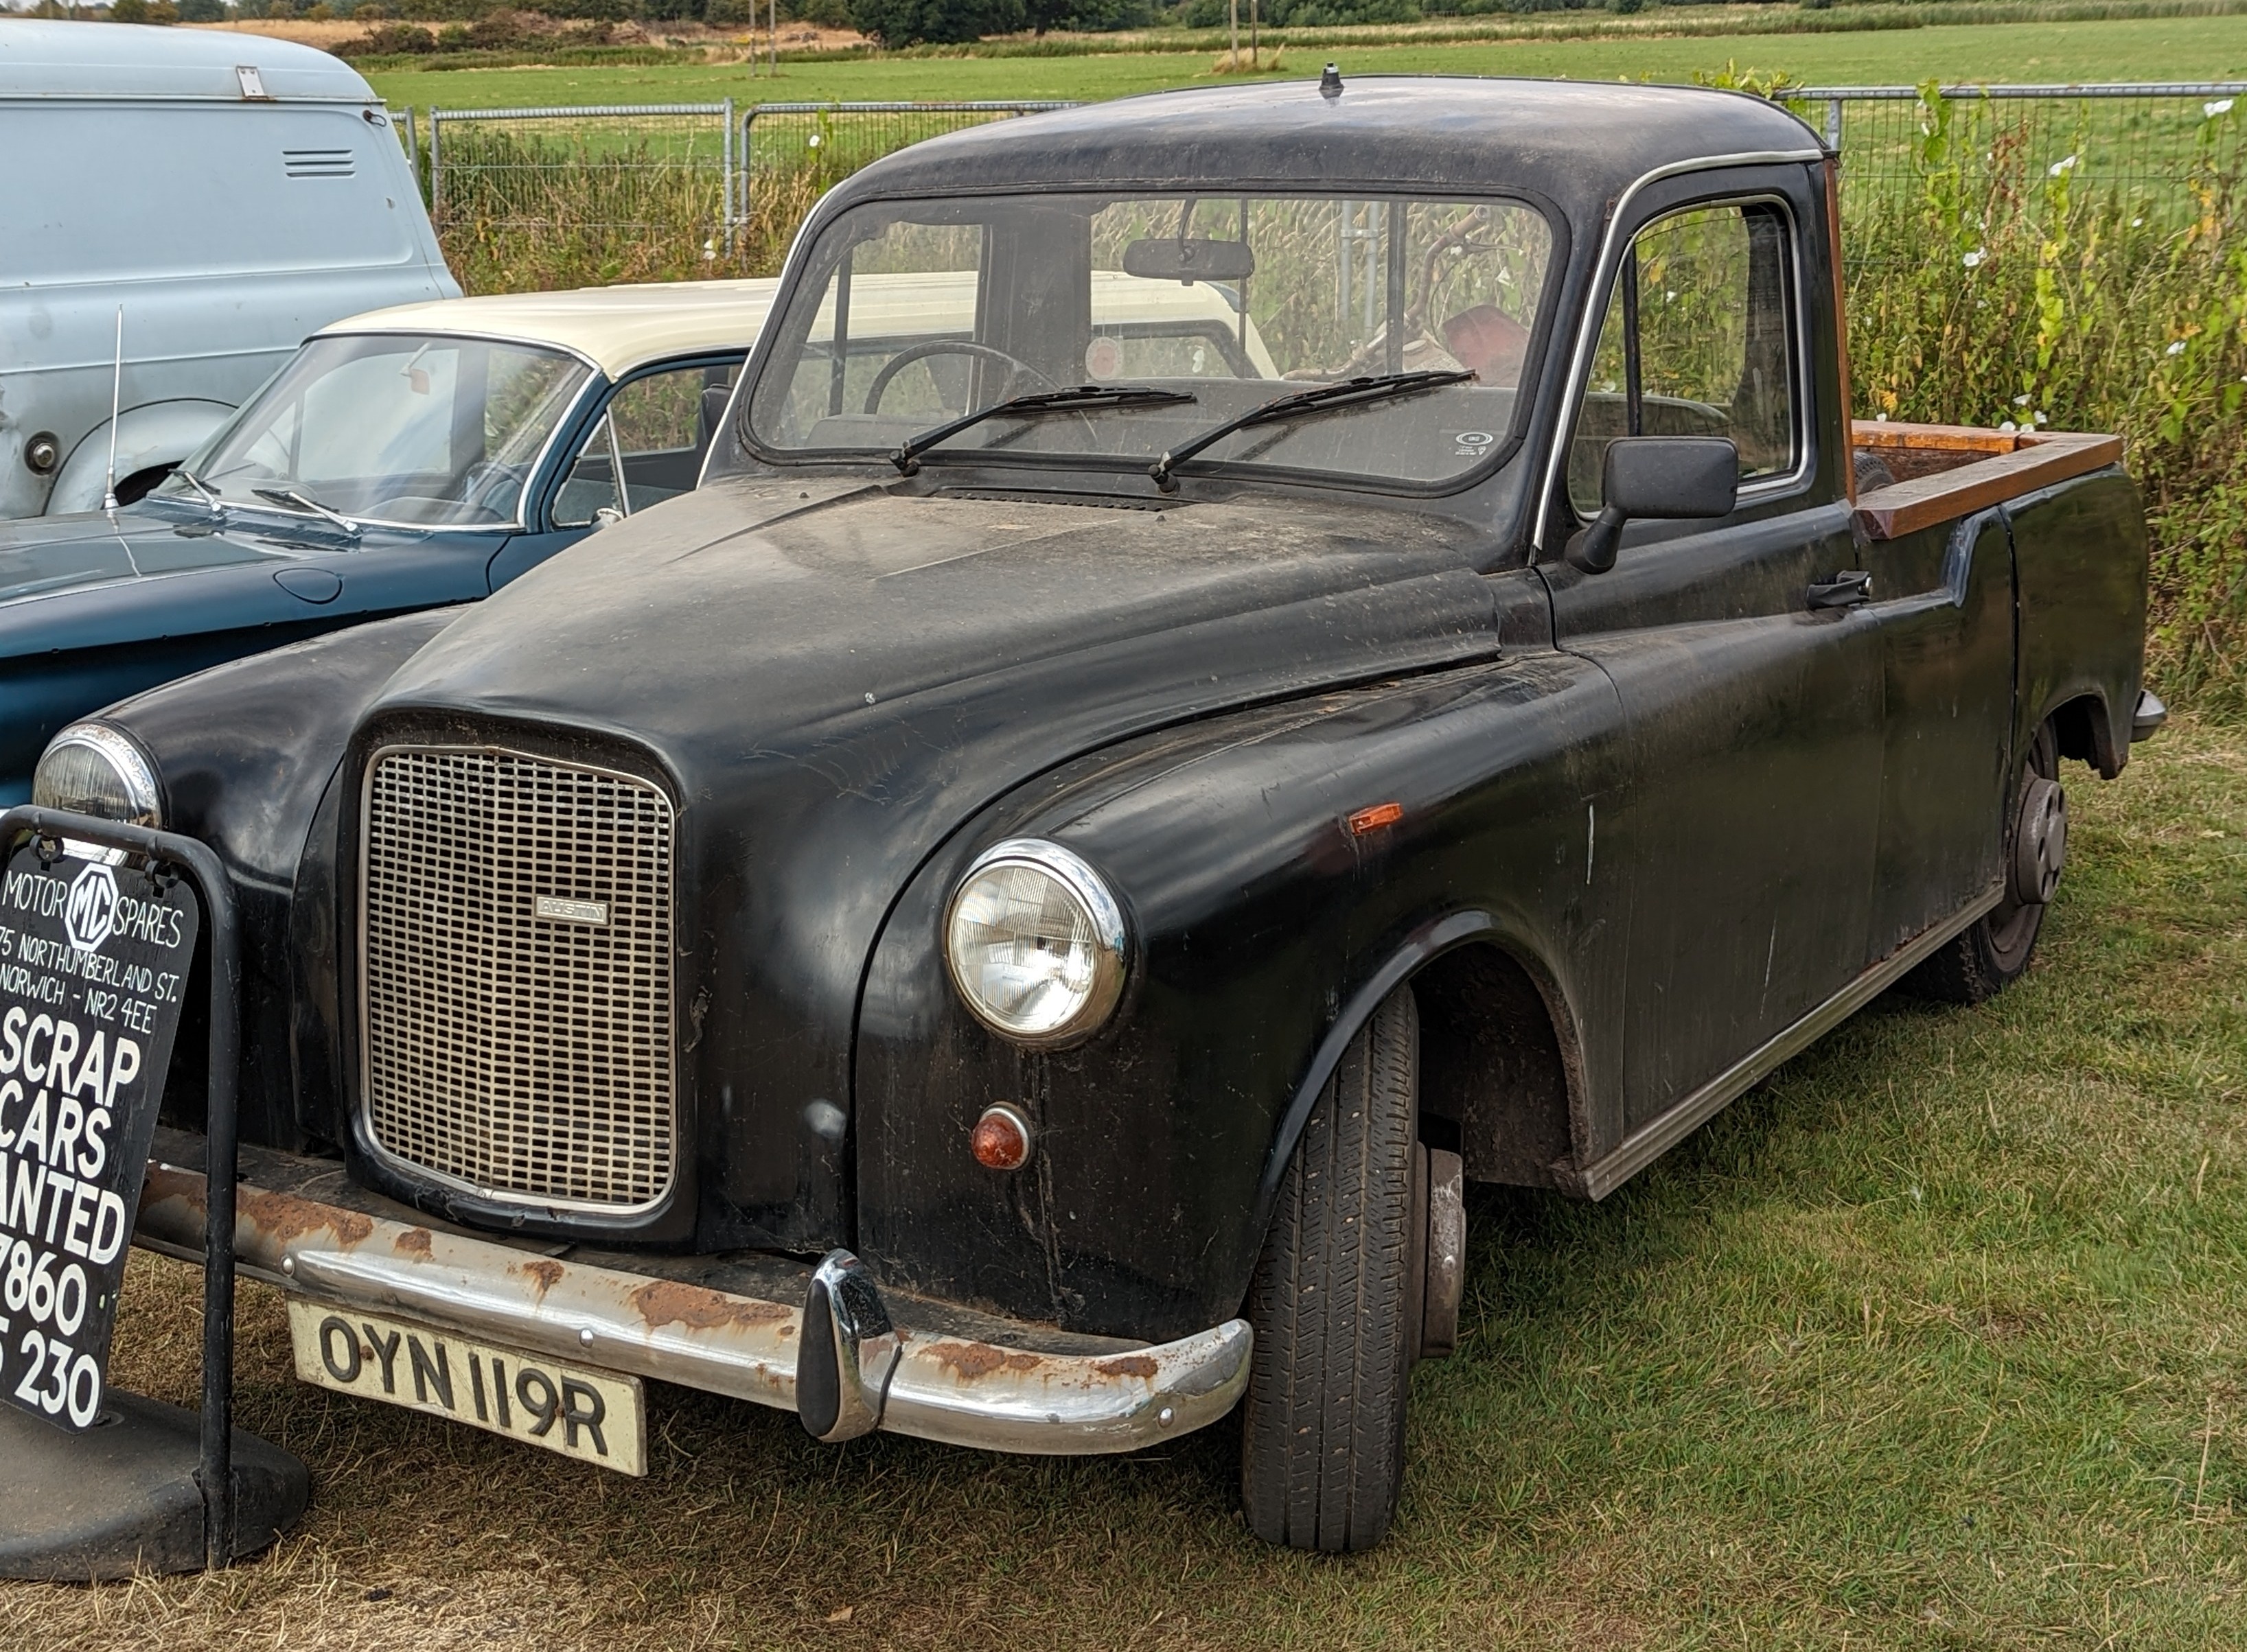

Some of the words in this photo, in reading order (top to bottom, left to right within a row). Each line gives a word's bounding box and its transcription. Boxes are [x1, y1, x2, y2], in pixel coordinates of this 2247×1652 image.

[2, 870, 68, 919] MOTOR
[113, 896, 184, 948] SPARES
[0, 963, 66, 1005] NORWICH
[84, 988, 117, 1021] NR2
[121, 997, 158, 1034] 4EE
[18, 933, 152, 993] NORTHUMBERLAND
[154, 972, 180, 1003] ST.
[0, 1006, 141, 1108] SCRAP
[0, 1079, 112, 1179] CARS
[14, 1329, 100, 1428] 230
